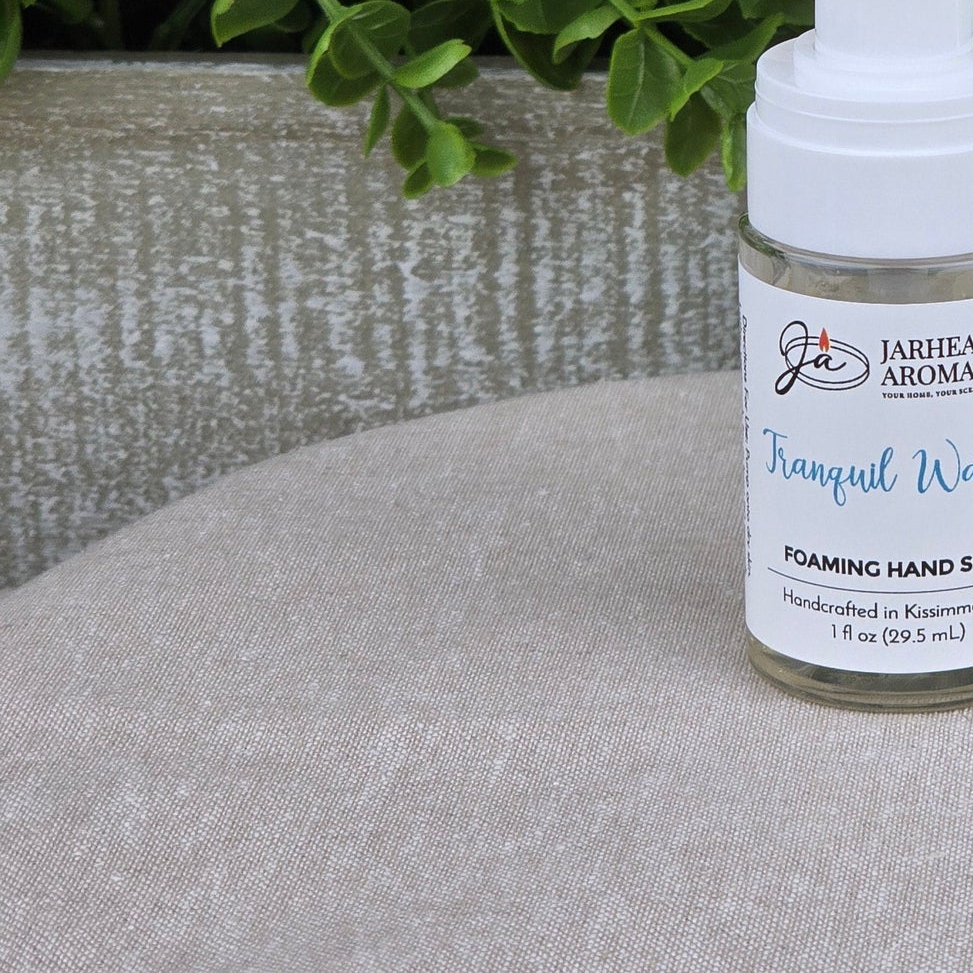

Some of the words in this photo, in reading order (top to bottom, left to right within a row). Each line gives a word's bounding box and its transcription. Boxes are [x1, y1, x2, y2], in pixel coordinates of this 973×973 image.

[882, 391, 905, 400] YOUR
[935, 388, 958, 398] YOUR
[762, 427, 898, 507] Tranquil
[783, 544, 881, 578] FOAMING
[887, 558, 955, 578] HAND
[783, 586, 878, 619] Handcrafted
[884, 605, 899, 620] in
[831, 624, 837, 639] 1
[842, 624, 852, 641] fl
[858, 631, 877, 644] oz
[882, 626, 926, 647] (29.5
[932, 622, 967, 643] mL)
